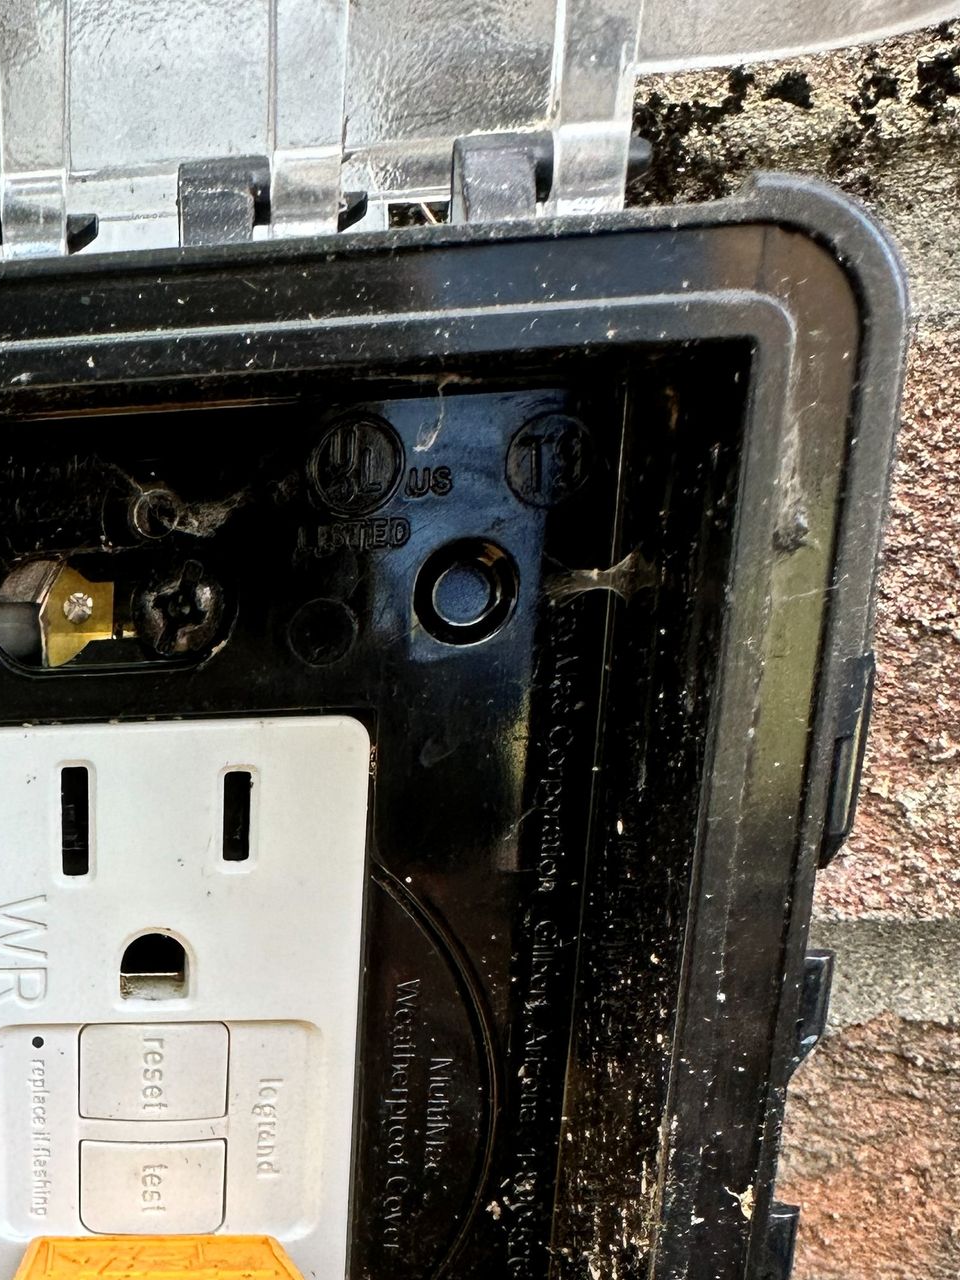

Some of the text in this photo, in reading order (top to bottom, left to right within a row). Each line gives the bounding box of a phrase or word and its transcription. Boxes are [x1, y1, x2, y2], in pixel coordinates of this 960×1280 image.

[405, 466, 453, 499] US
[296, 517, 412, 554] LISTED
[142, 1037, 168, 1110] reset
[382, 977, 423, 1253] Weatherproof Cover
[27, 1058, 52, 1216] replace if flashing
[252, 1077, 284, 1174] legrand
[422, 1056, 454, 1178] MultiMac
[141, 1163, 168, 1212] test
